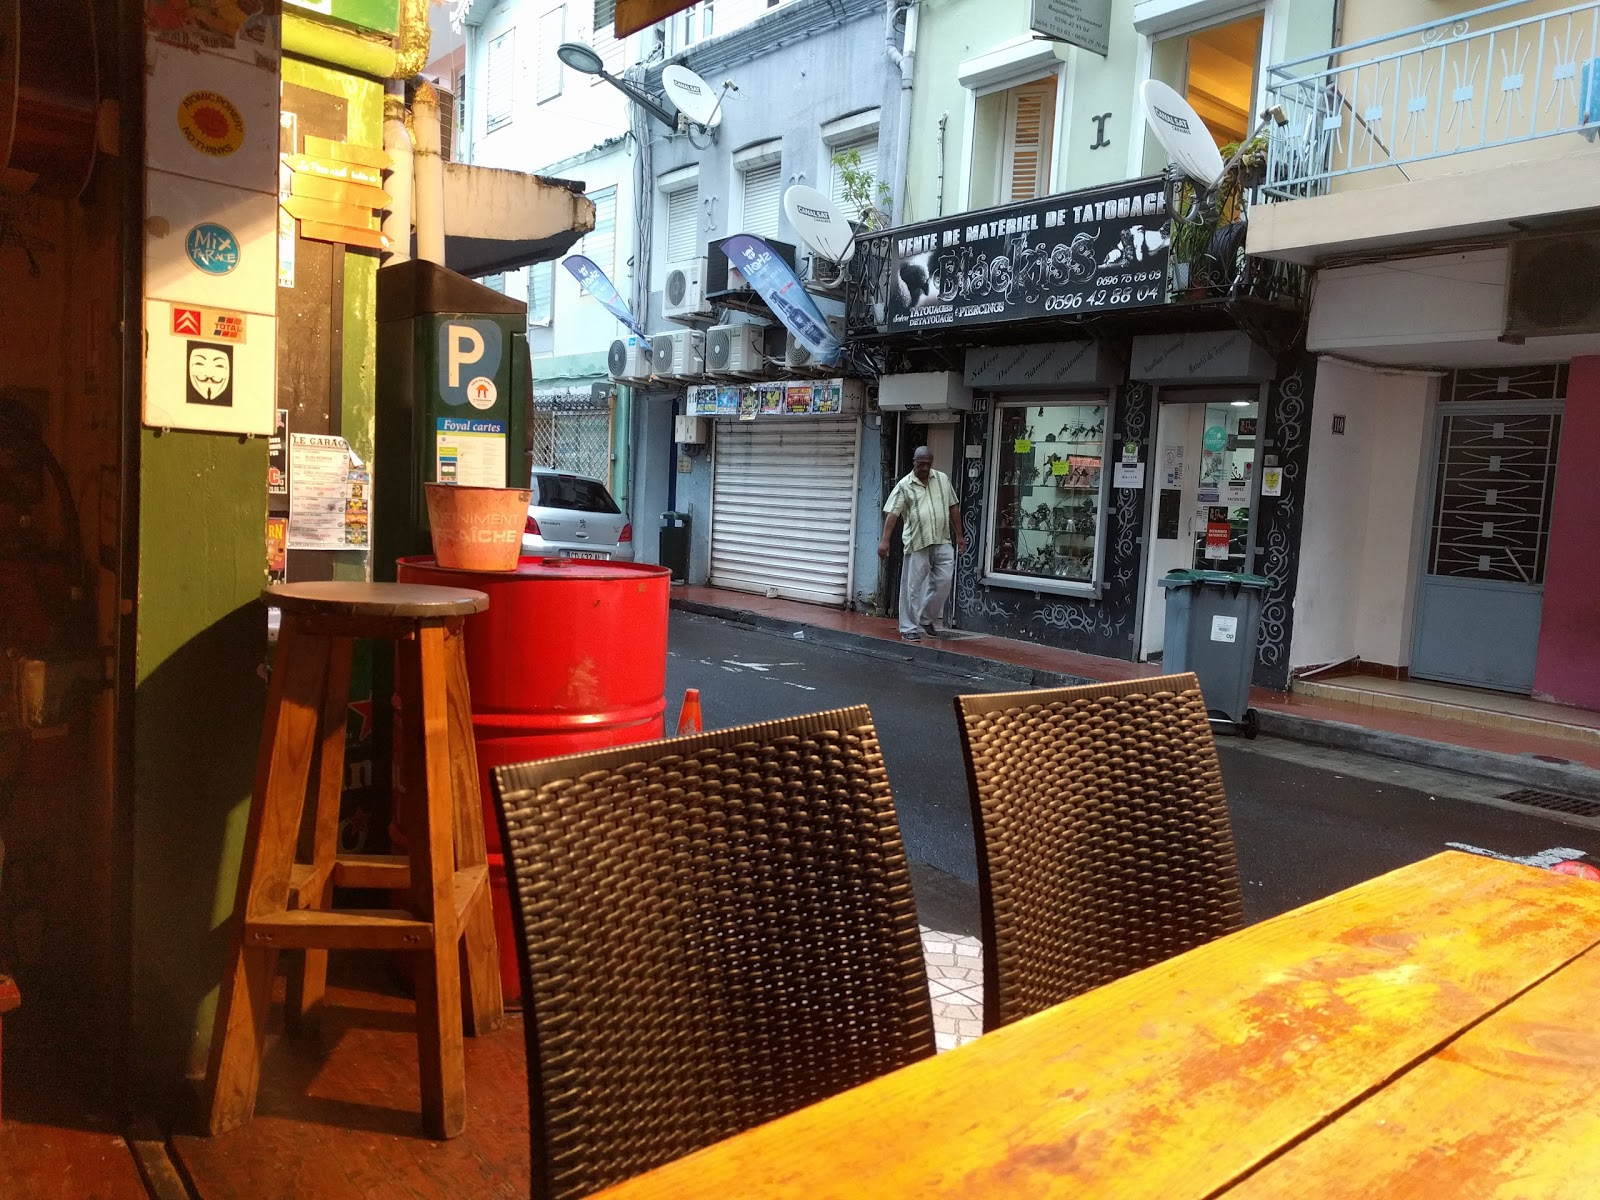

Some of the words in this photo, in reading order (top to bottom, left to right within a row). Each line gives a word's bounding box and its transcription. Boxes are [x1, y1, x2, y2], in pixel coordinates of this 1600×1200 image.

[183, 92, 215, 110] ATOMIC
[215, 96, 243, 133] POWER?
[1155, 108, 1188, 129] CANALSAT
[182, 126, 196, 142] NO
[196, 139, 234, 155] THANKS
[798, 206, 829, 219] CANALSAT
[898, 233, 937, 259] VENTE
[942, 229, 961, 248] DE
[1045, 209, 1066, 228] DE
[1073, 191, 1166, 224] TATOUAGE
[1096, 275, 1118, 286] 0696
[1121, 274, 1132, 283] 75
[1134, 271, 1146, 282] 03
[1149, 270, 1161, 280] 03
[1045, 292, 1083, 311] 0596
[1086, 289, 1107, 306] 42
[1110, 286, 1133, 304] 88
[1136, 283, 1160, 301] 04
[909, 304, 953, 318] TATOUAGES
[959, 301, 1005, 317] PIERCINGS
[215, 322, 241, 333] TOTAL
[448, 324, 485, 388] P
[970, 352, 999, 381] Salon
[975, 399, 986, 411] 114
[443, 419, 471, 432] Foyal
[472, 422, 501, 432] cartes
[293, 436, 306, 444] LE
[310, 438, 347, 448] GARAG
